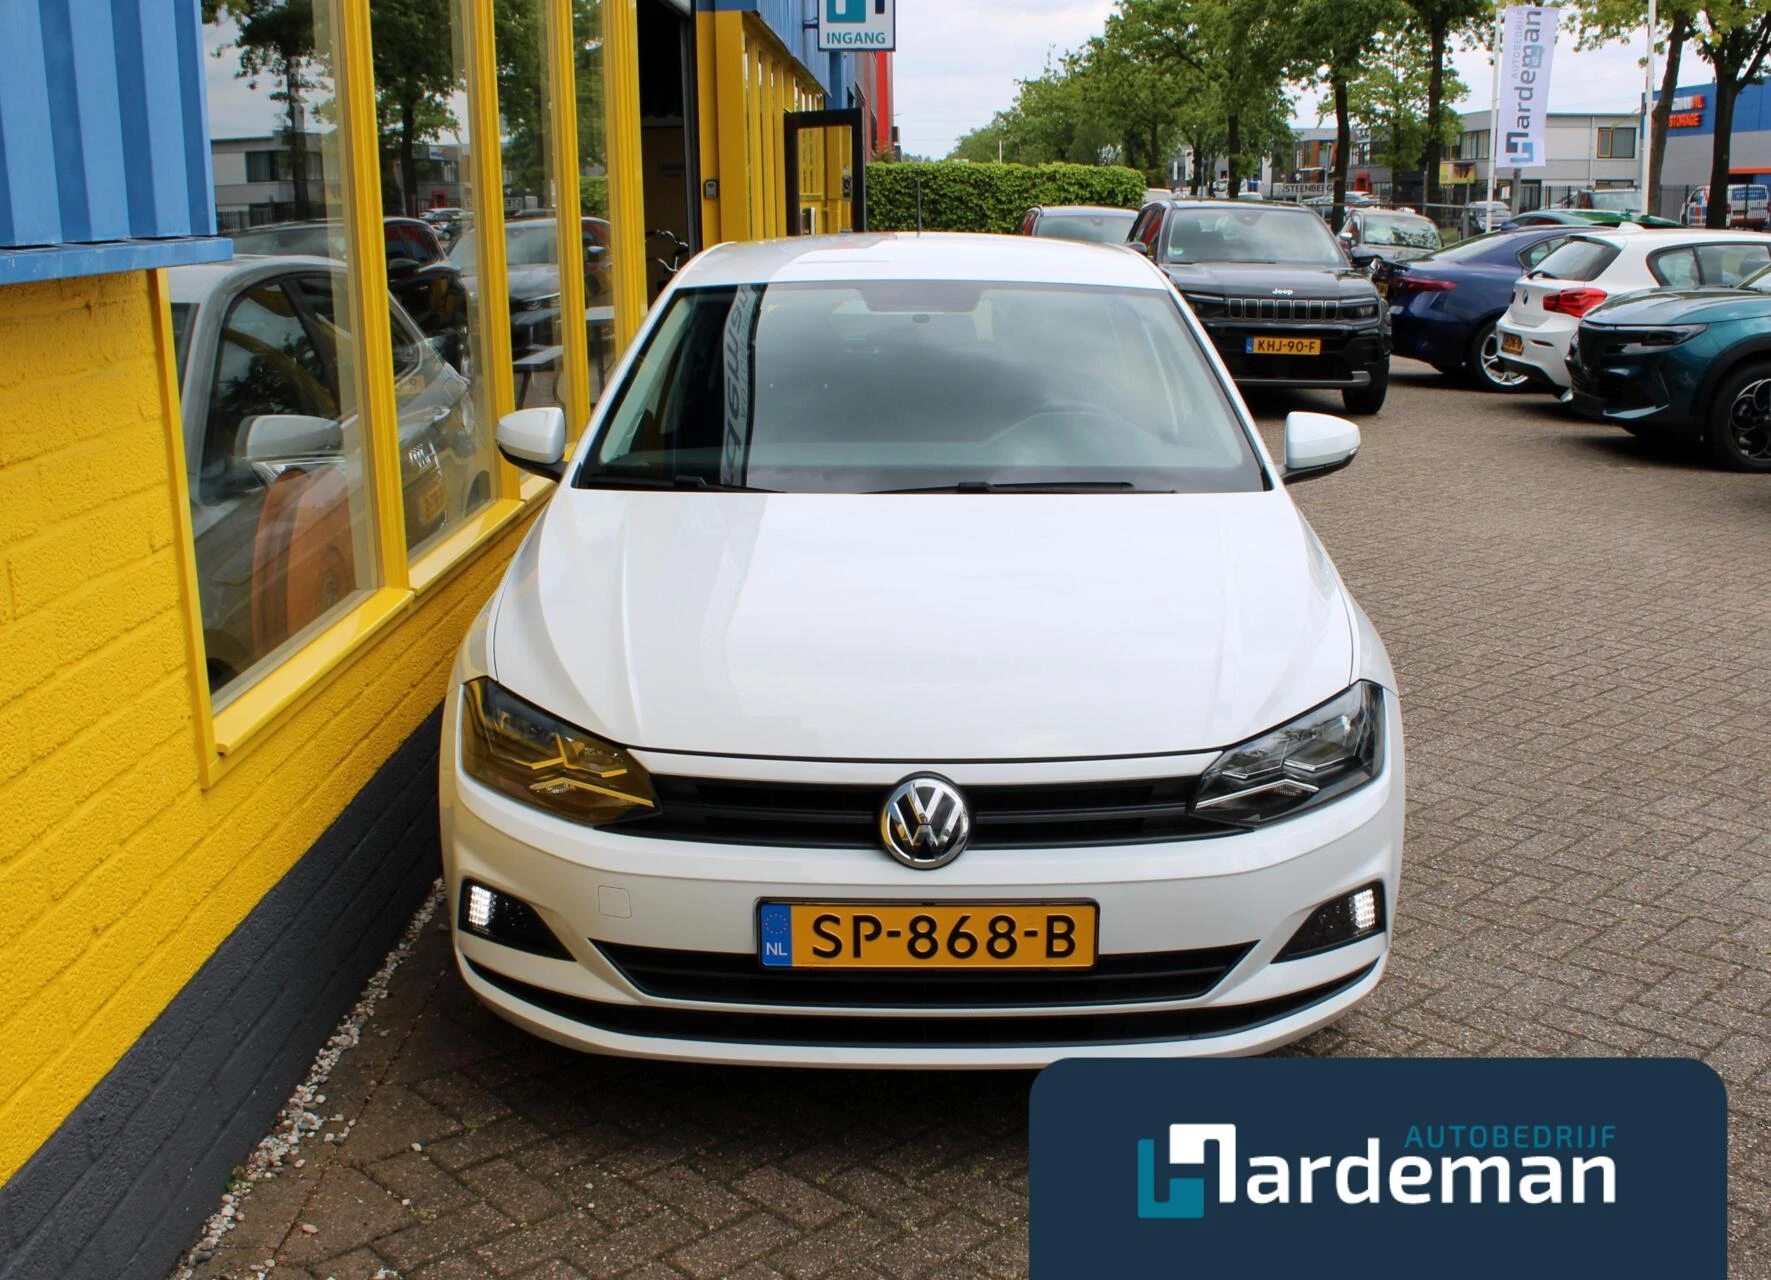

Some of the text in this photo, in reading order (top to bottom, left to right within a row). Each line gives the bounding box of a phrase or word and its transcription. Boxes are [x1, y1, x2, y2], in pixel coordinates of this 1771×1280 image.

[826, 31, 887, 45] INGANG
[1506, 10, 1543, 163] Hardeman
[1272, 288, 1294, 296] Jeep
[1257, 340, 1317, 353] KHJ-90-F
[884, 778, 967, 865] VW
[811, 913, 1077, 960] SP-868-B
[765, 942, 788, 956] NL
